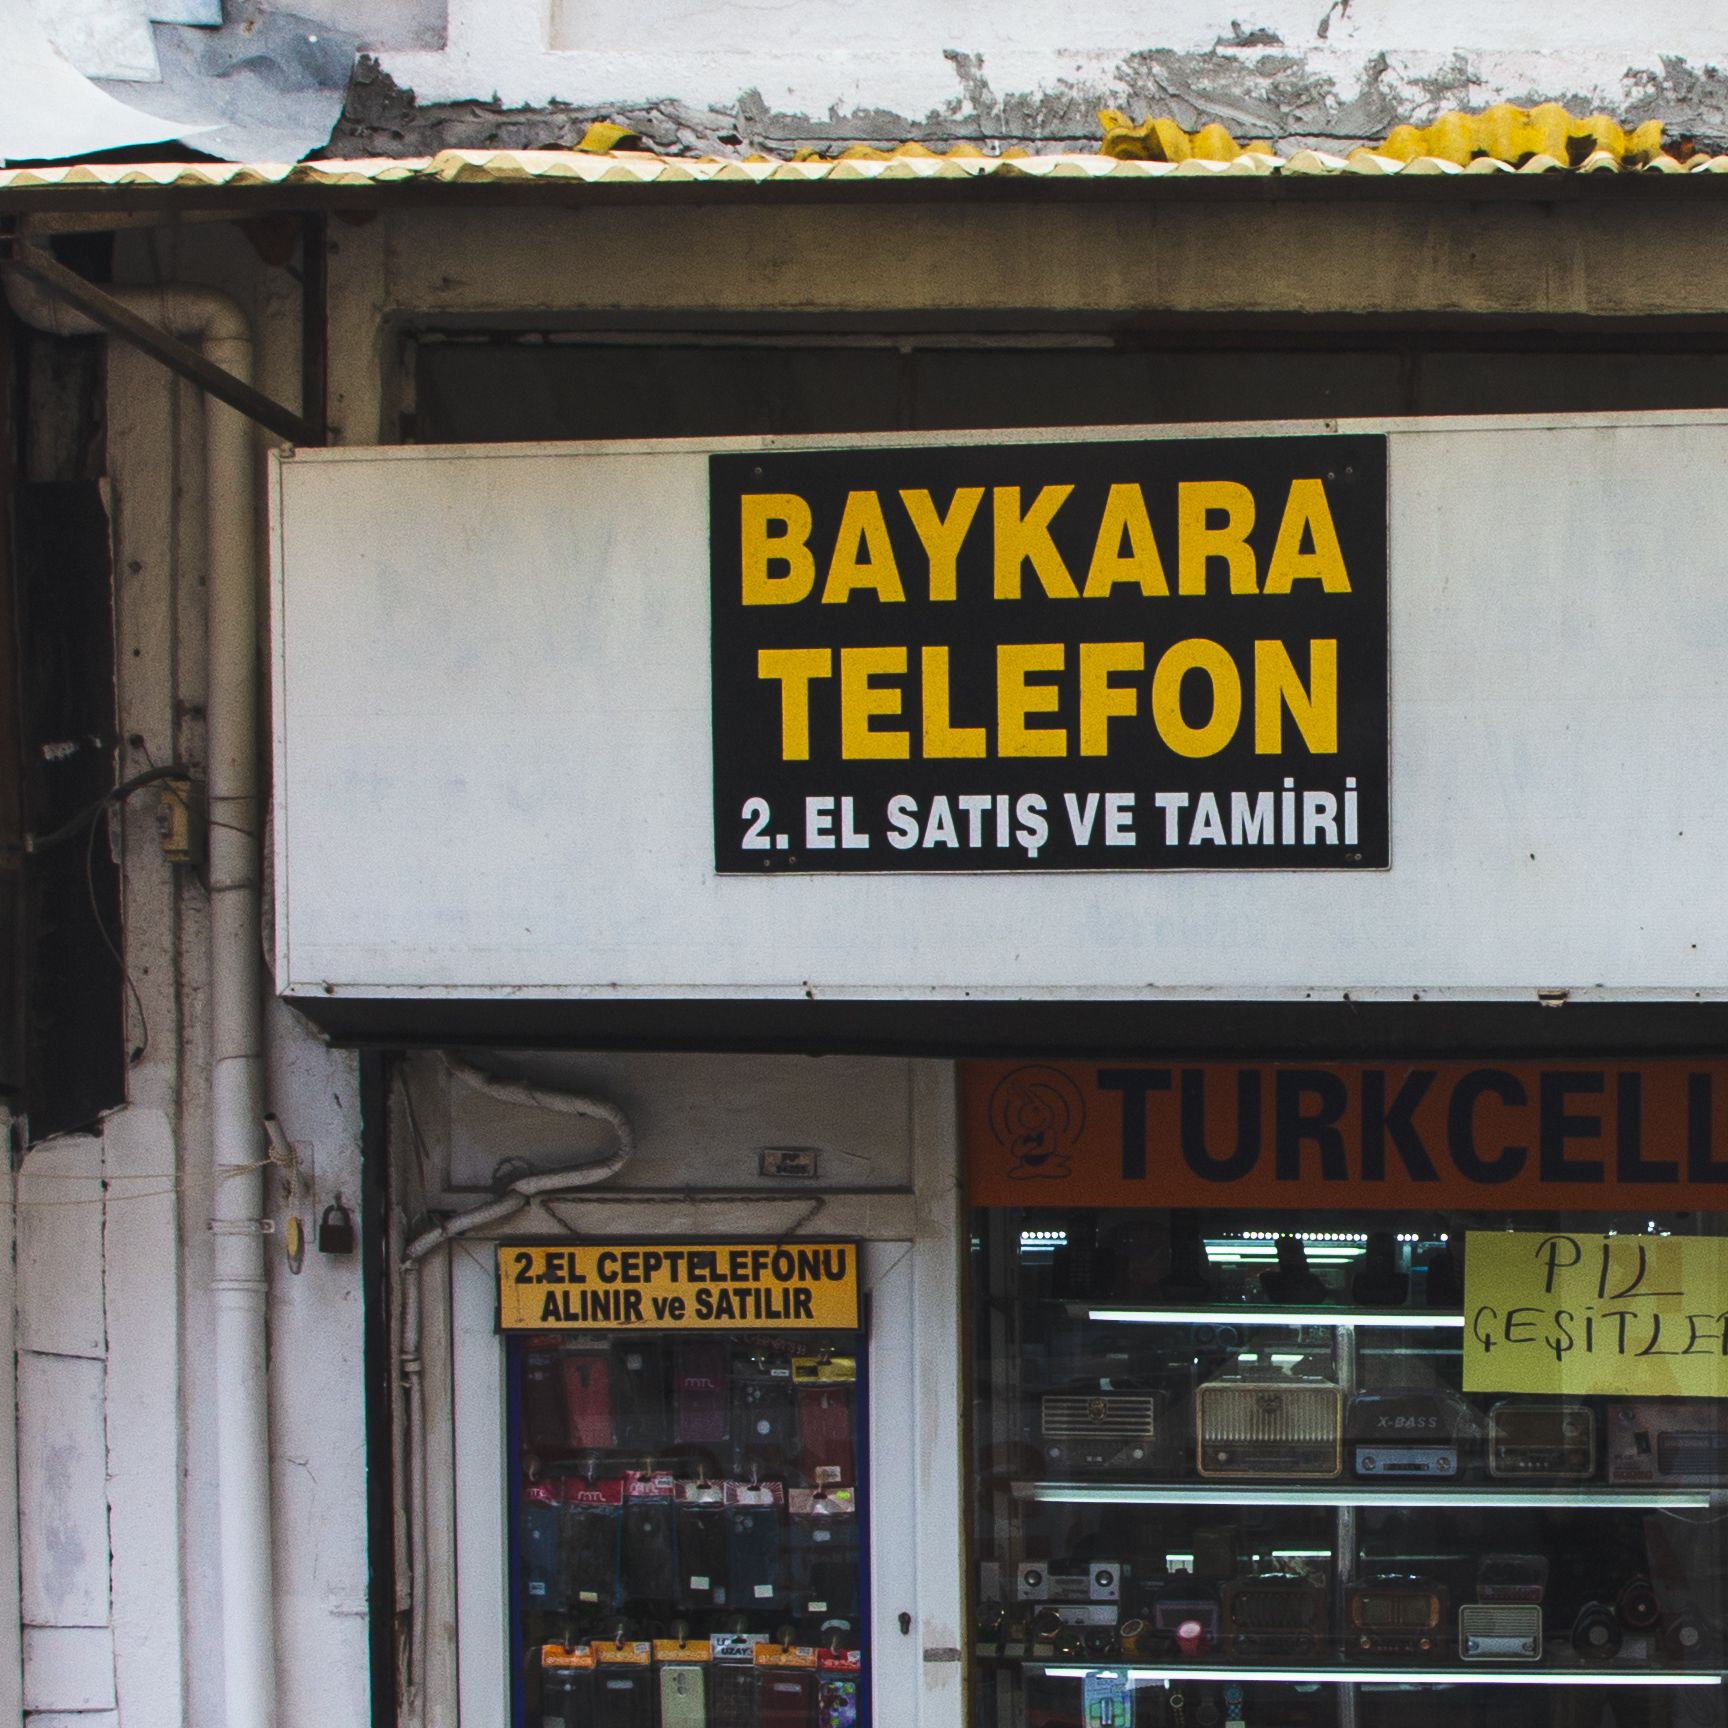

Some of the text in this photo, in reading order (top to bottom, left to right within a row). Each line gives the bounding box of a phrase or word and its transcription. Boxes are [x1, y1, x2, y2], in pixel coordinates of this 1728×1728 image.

[740, 478, 1352, 606] BAYKARA
[757, 638, 1338, 761] TELEFON
[741, 777, 1359, 858] 2. EL SATIŞ VE TAMİRİ
[541, 1287, 814, 1322] ALINIR ve SATILIR
[596, 1248, 847, 1283] CEPTELEFONU
